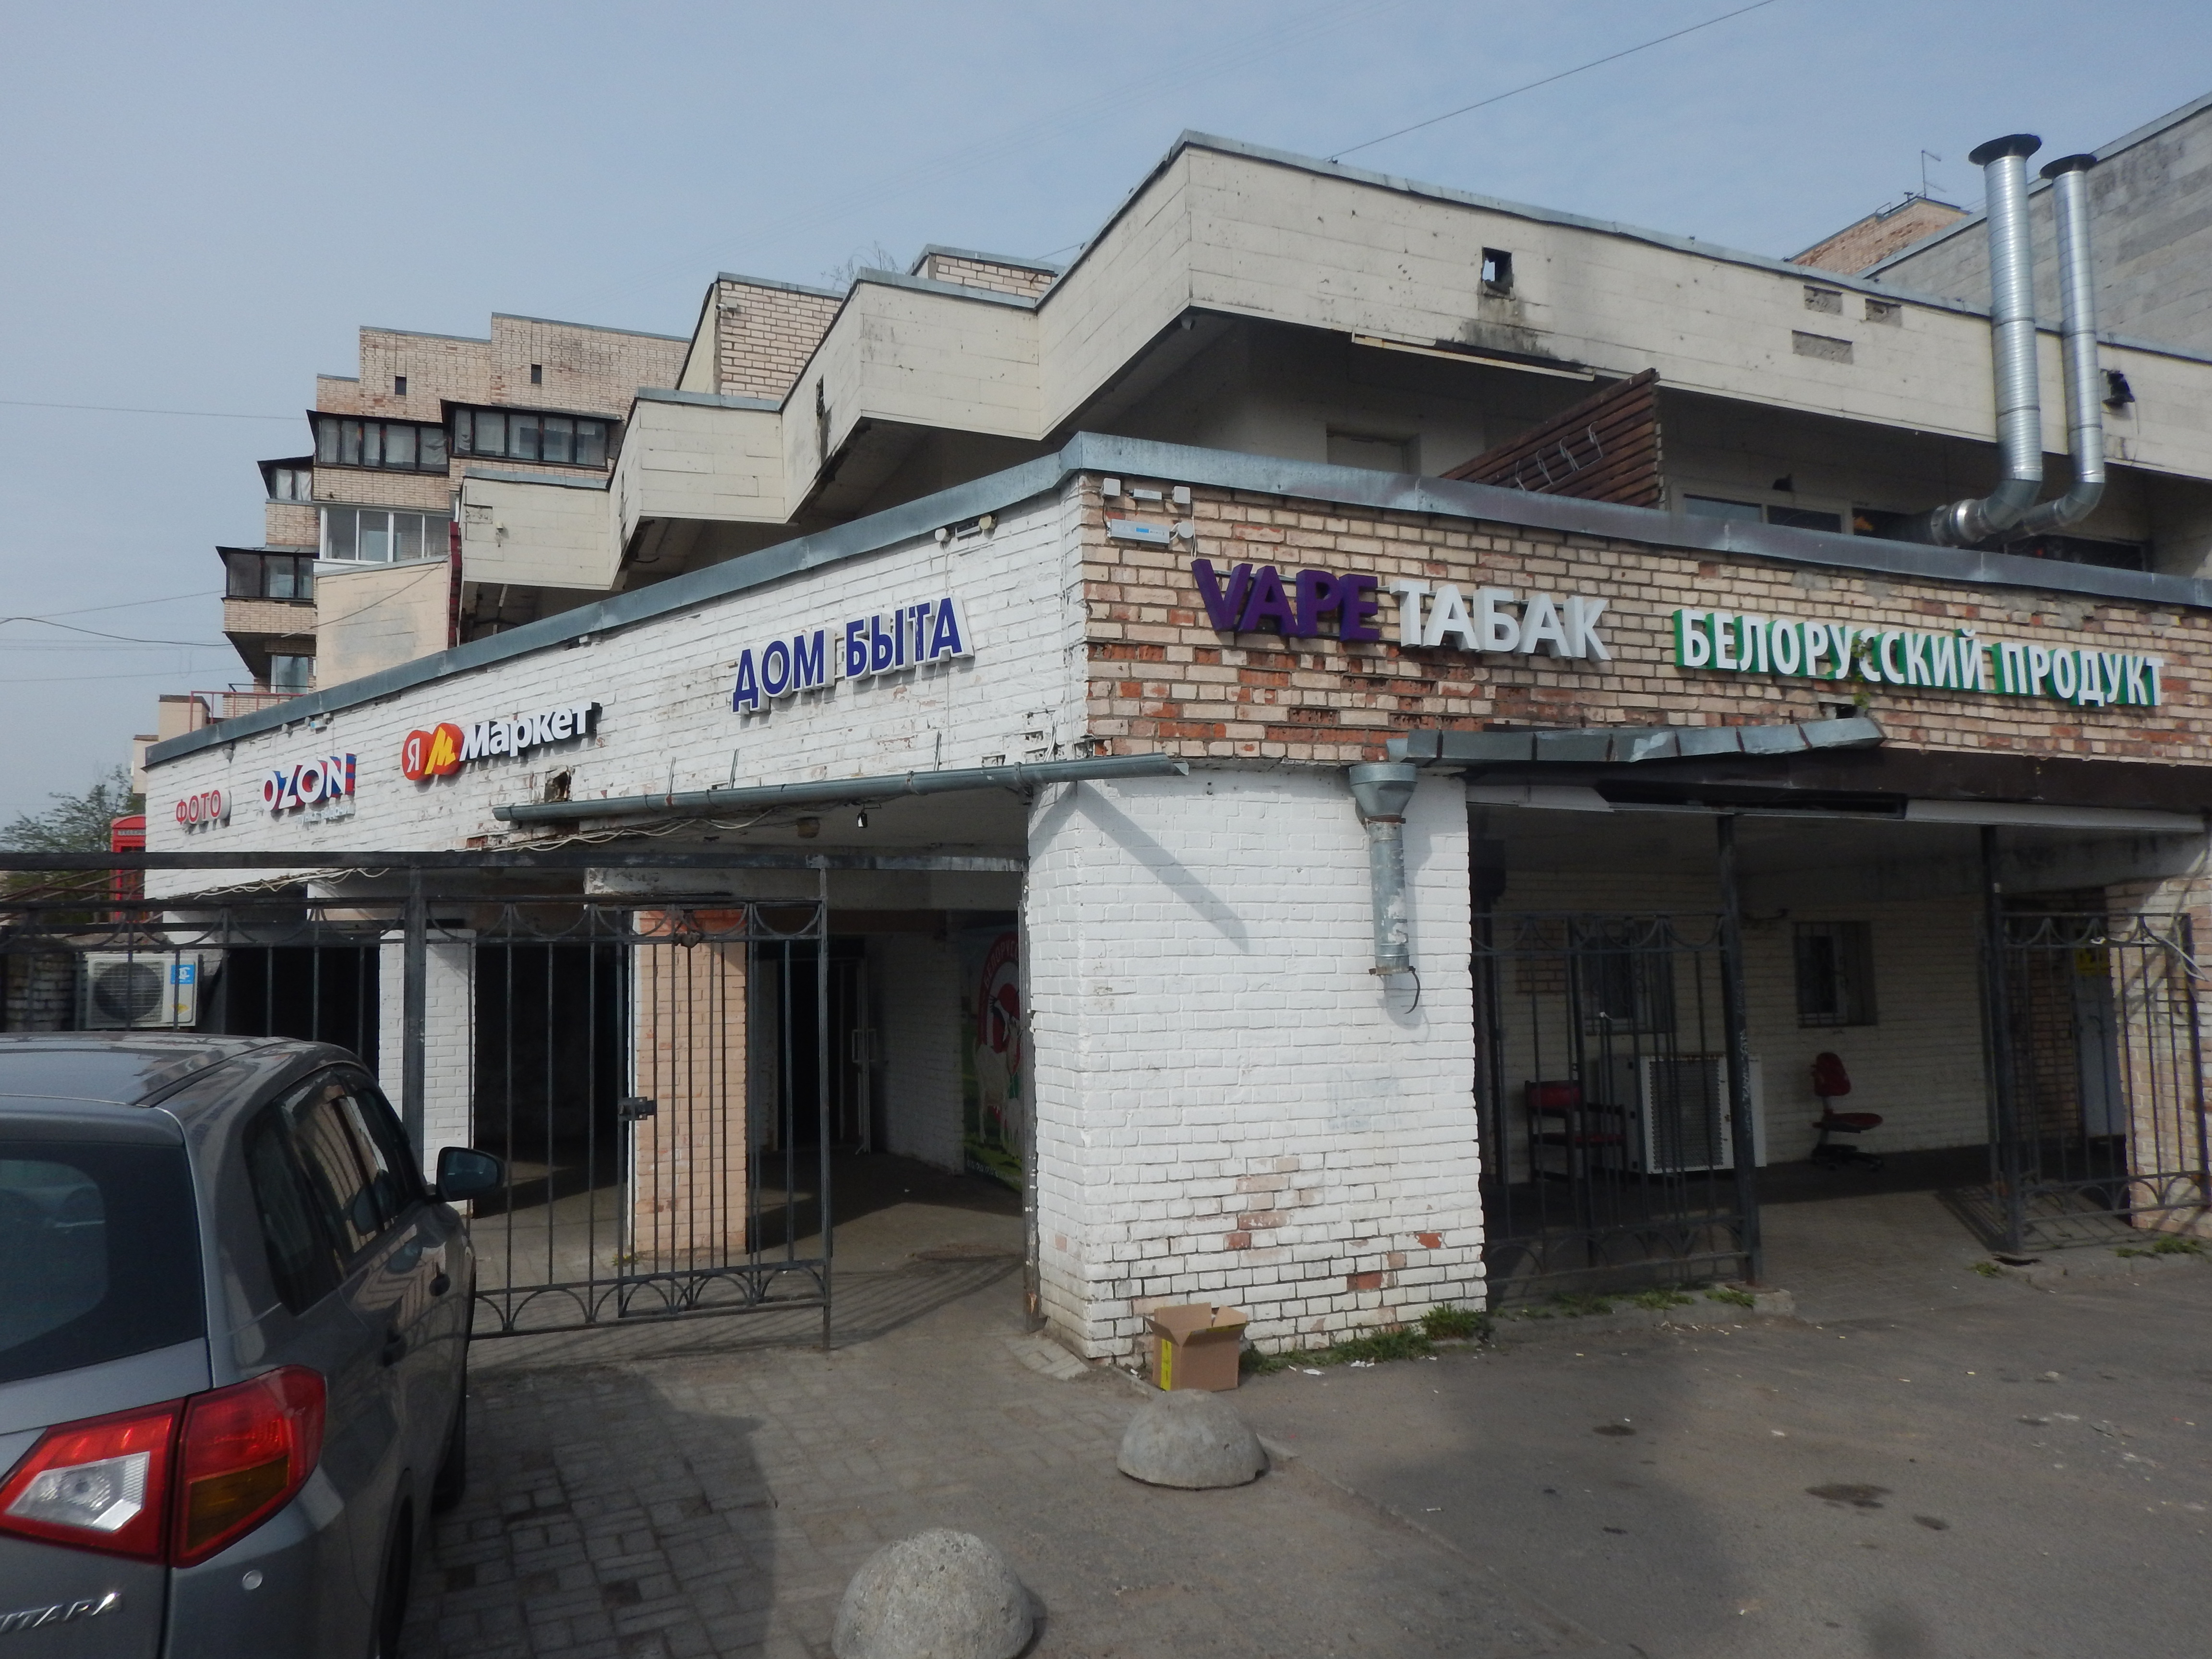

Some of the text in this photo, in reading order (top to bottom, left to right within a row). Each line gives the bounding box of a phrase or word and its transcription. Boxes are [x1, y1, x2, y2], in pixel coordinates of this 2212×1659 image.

[1191, 558, 1378, 644] VAPE
[1390, 577, 1612, 663] ТАБАК
[732, 596, 967, 714] ДОМ БЫТА
[1676, 609, 2164, 707] БЕЛОРУССКИЙ ПРОДУКТ
[459, 702, 595, 762] Маркет
[176, 790, 222, 825] ФОТО
[262, 753, 354, 811] OZON
